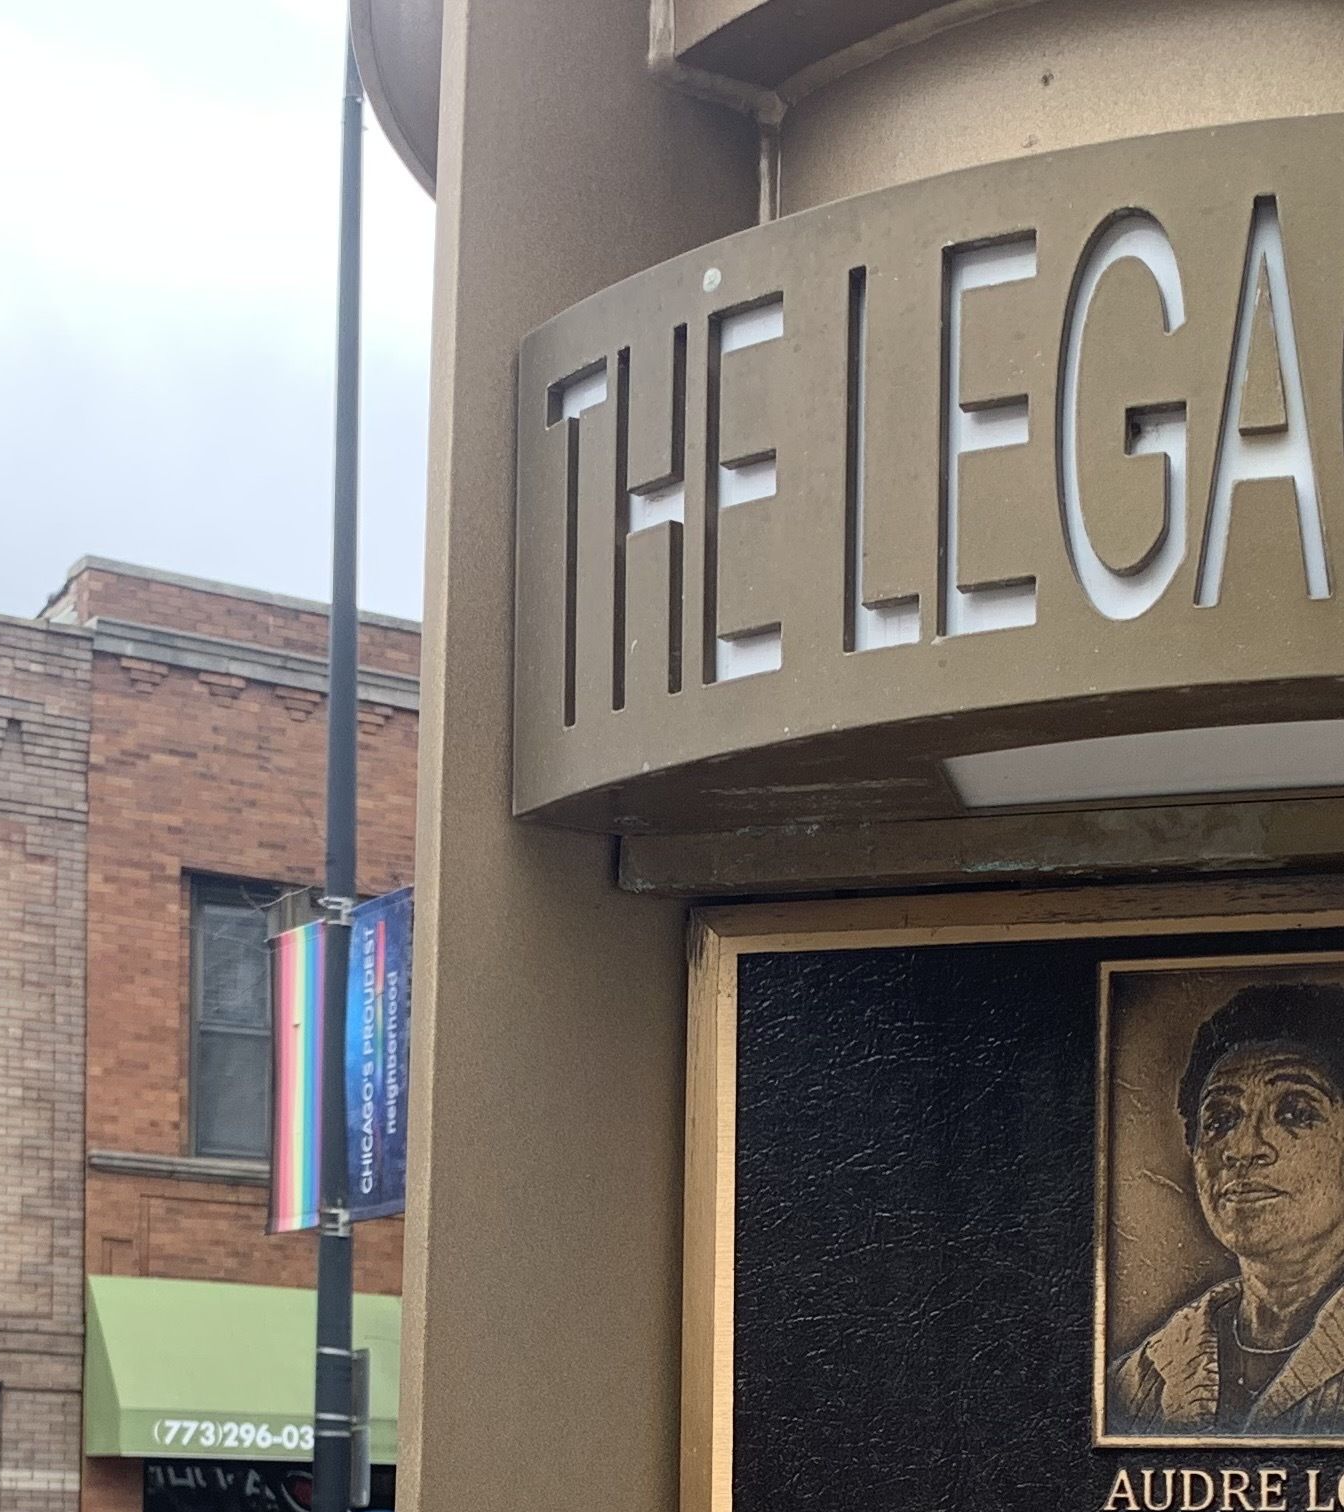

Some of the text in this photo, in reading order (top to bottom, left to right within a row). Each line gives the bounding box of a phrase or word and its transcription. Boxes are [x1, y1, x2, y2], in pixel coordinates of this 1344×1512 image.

[543, 290, 785, 728] THE
[360, 927, 376, 1194] CHICAGO'S PROUDEST
[386, 970, 399, 1135] neighborhood
[153, 1419, 315, 1450] (773)296-03
[1103, 1468, 1287, 1511] AUDRE
